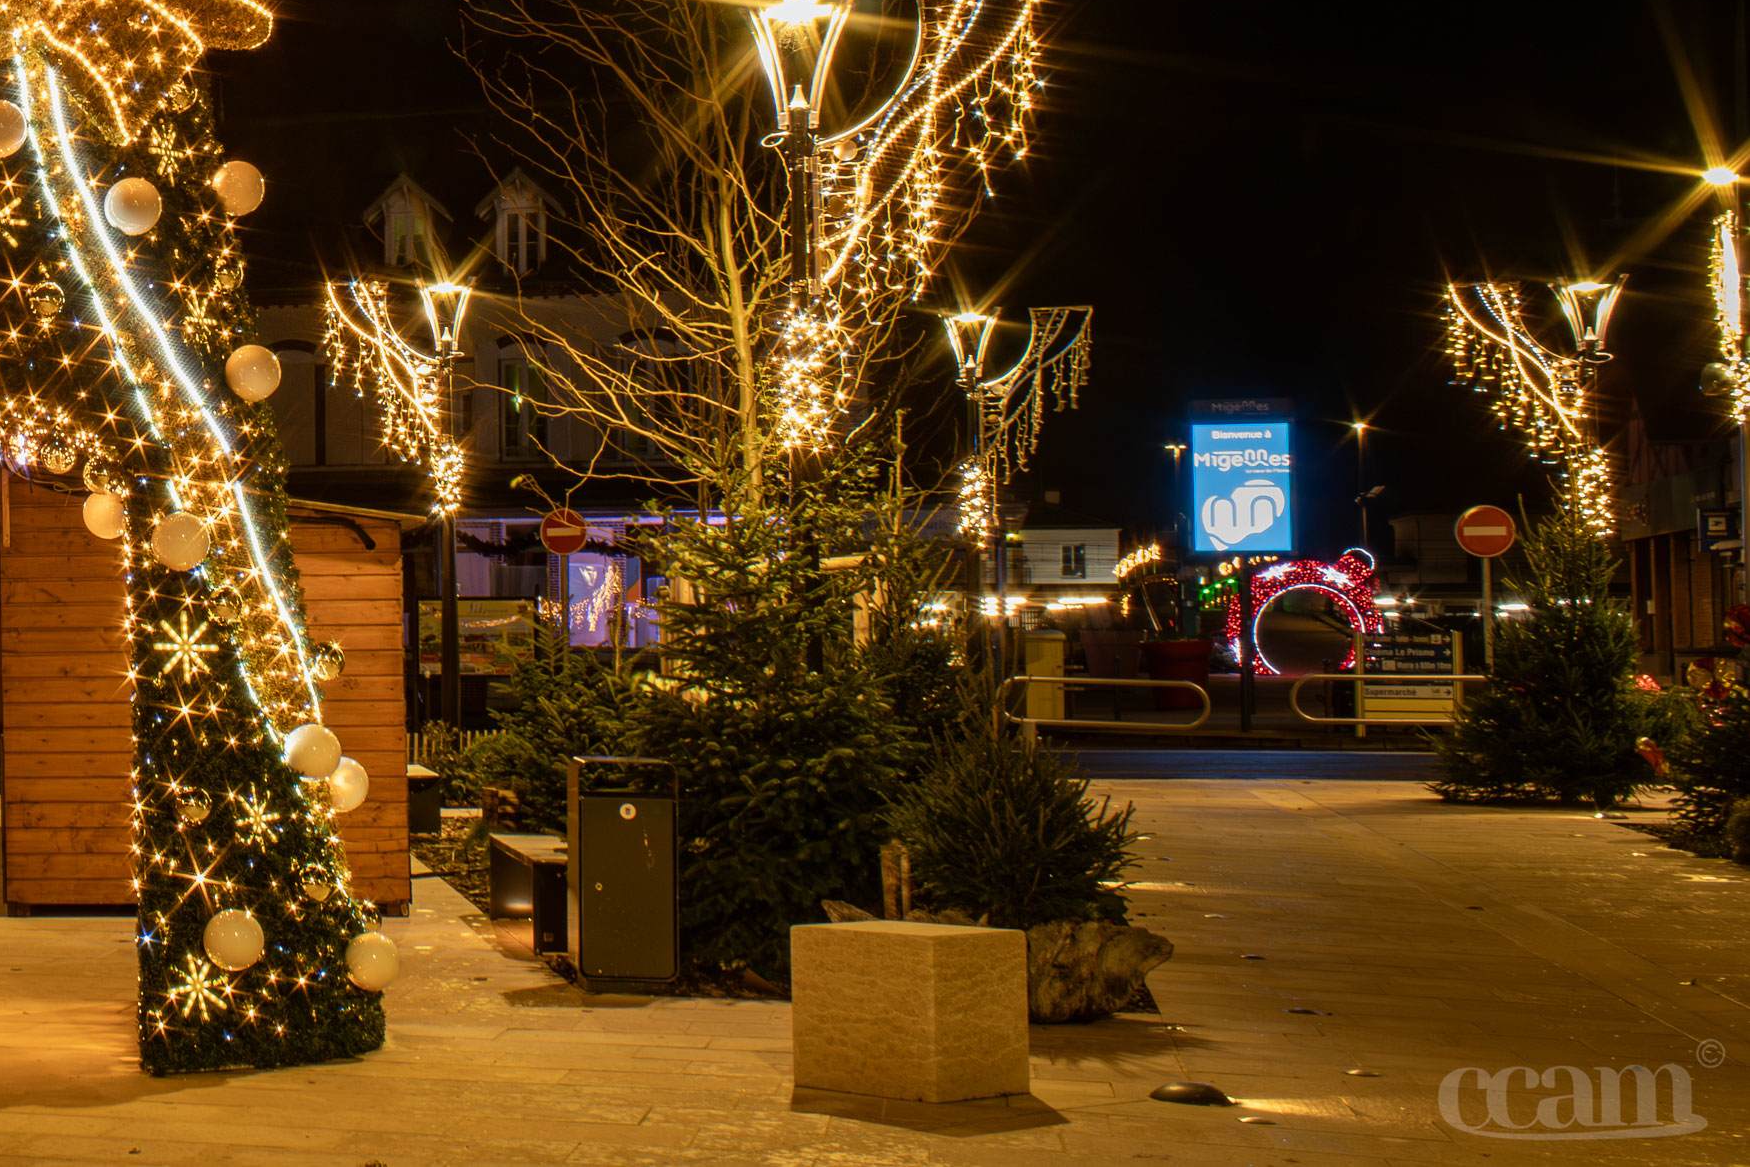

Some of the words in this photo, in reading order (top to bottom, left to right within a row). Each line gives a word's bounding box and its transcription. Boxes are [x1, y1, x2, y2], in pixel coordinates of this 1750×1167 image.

[1211, 400, 1270, 415] Migennes
[1211, 429, 1263, 439] Bienvenue
[1264, 429, 1272, 439] à
[1193, 448, 1291, 472] Migennes
[1395, 648, 1405, 656] Le
[1407, 648, 1435, 656] Prisme
[1364, 687, 1417, 697] Supermarché
